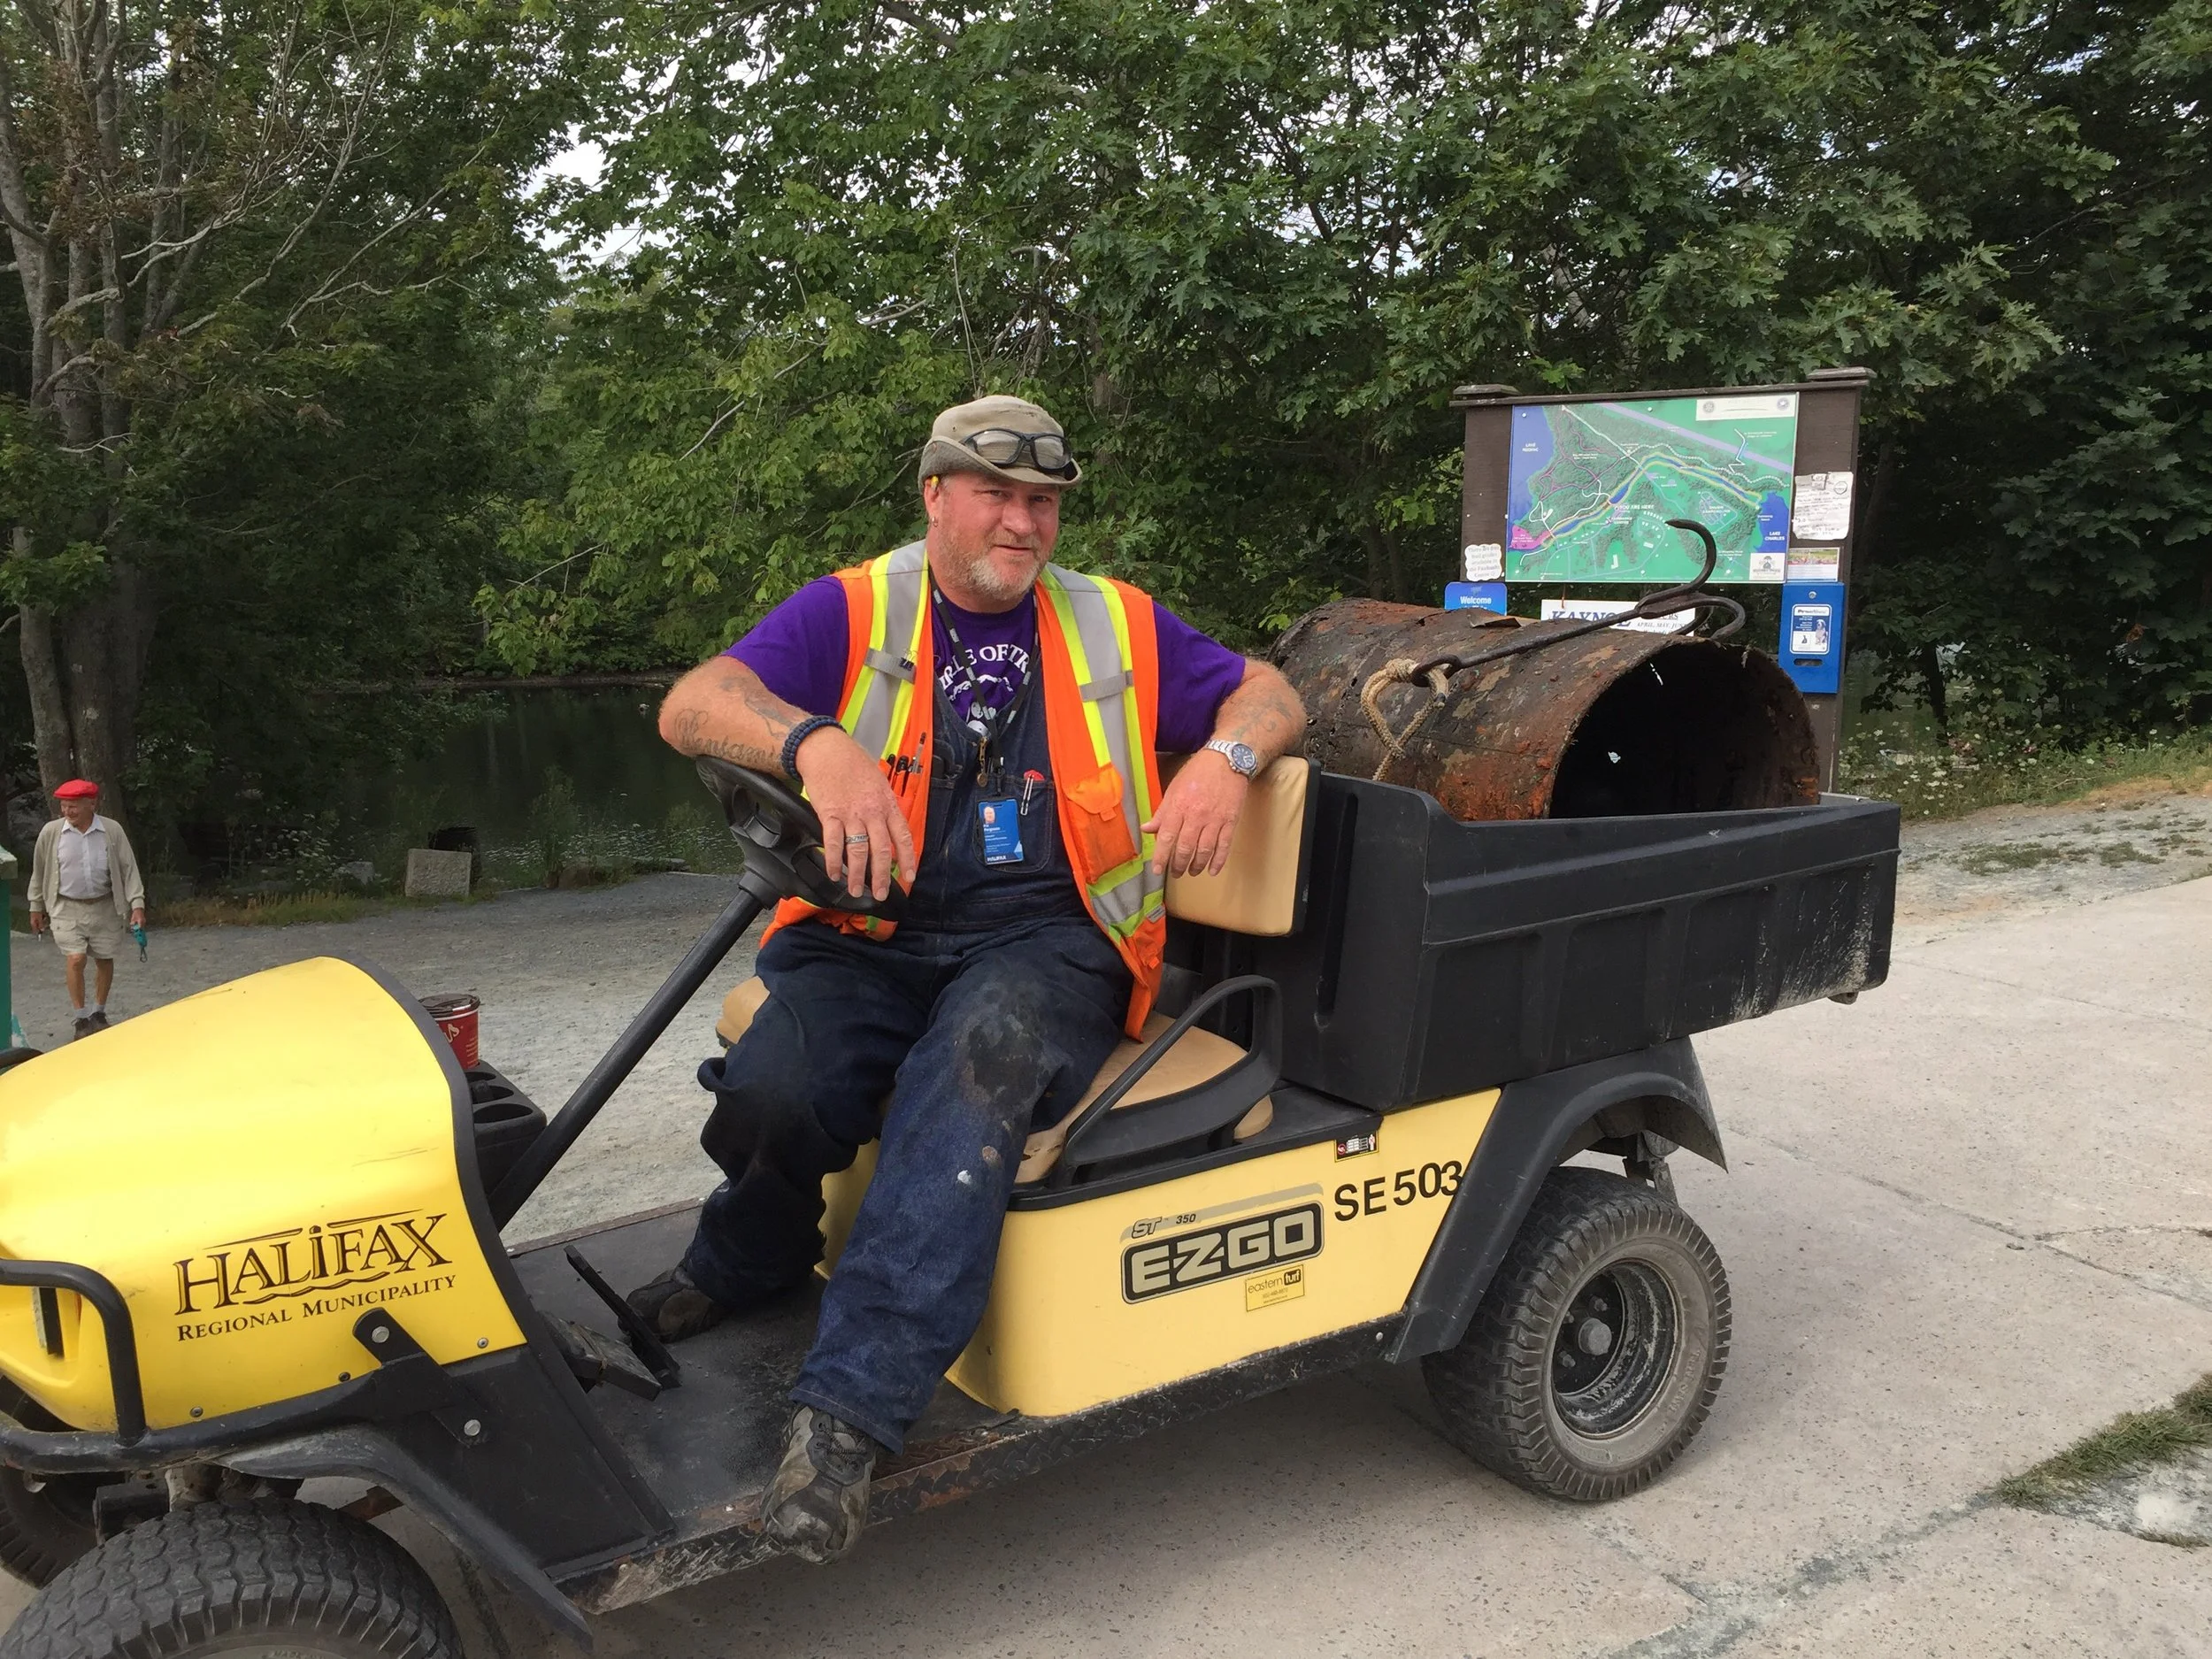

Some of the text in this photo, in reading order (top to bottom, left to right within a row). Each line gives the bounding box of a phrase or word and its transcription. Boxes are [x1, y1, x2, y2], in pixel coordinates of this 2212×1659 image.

[1460, 595, 1492, 604] Welcome
[979, 644, 1009, 662] OF
[1394, 1159, 1464, 1206] 503
[1132, 1213, 1196, 1239] ST 350
[1248, 1277, 1283, 1294] eastern
[1286, 1270, 1301, 1284] turf
[178, 1274, 457, 1341] REGIONAL MUNICIPALITY
